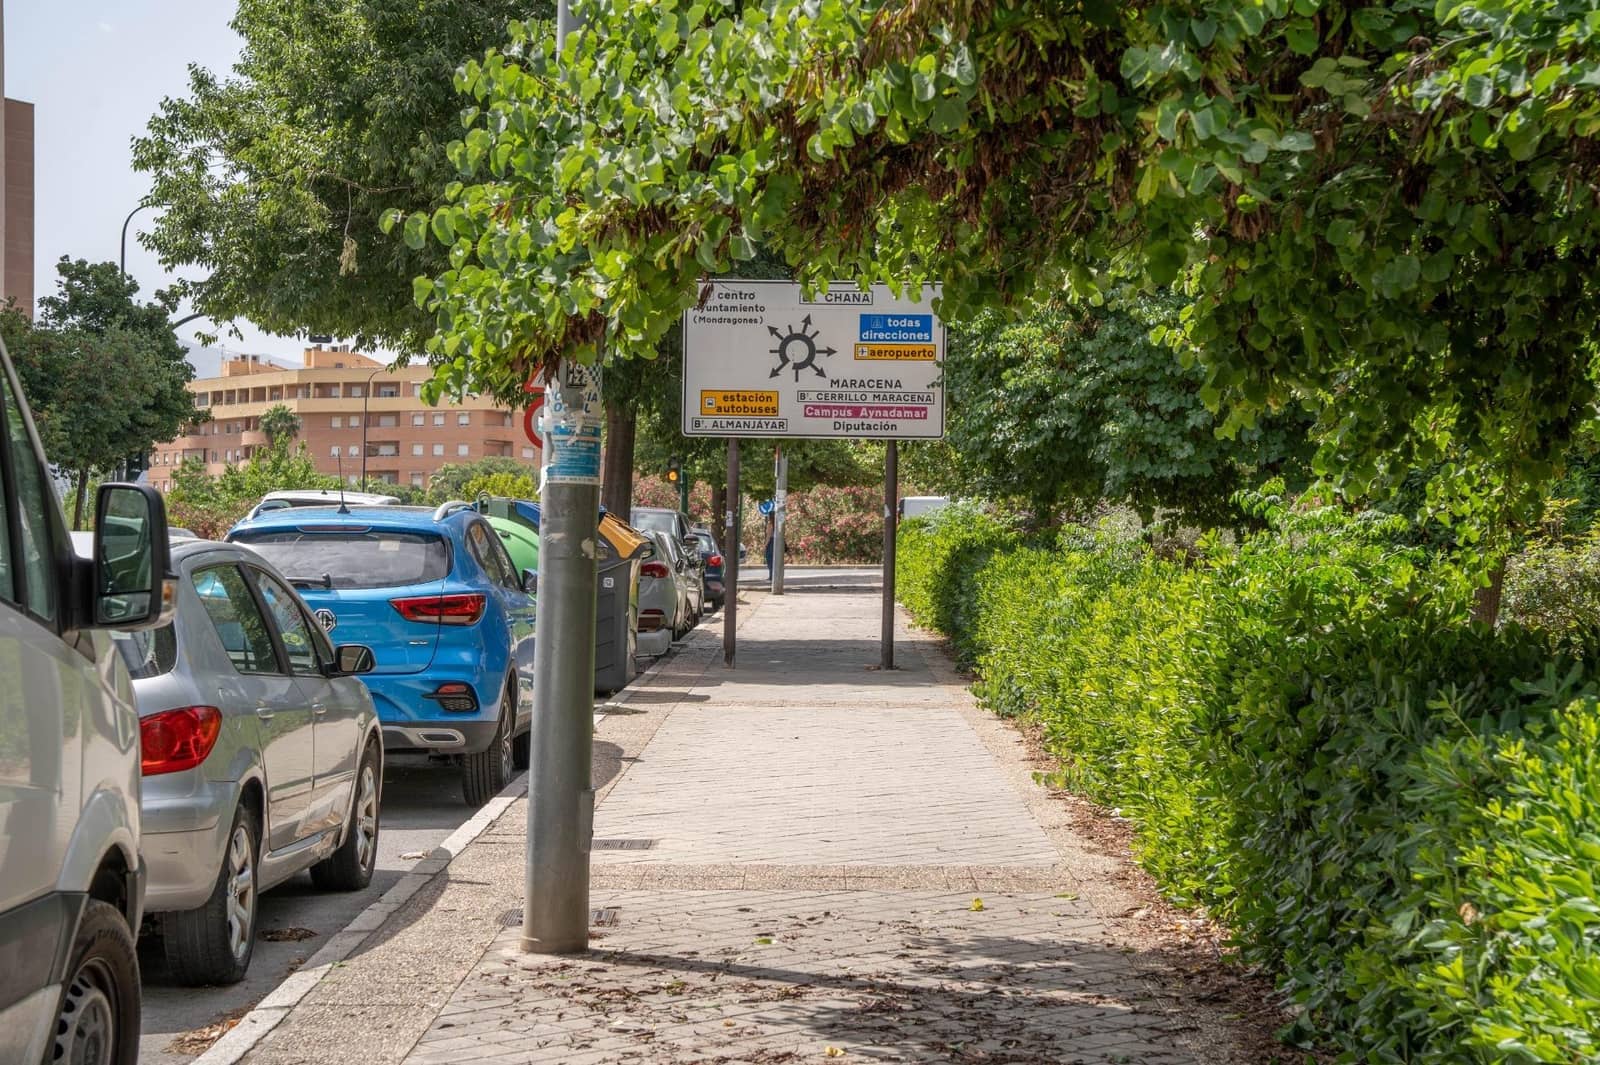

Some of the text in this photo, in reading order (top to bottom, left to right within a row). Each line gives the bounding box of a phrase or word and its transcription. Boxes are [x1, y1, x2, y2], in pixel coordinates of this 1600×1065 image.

[717, 291, 756, 300] centro
[824, 293, 871, 303] CHANA
[693, 315, 764, 326] (Mondragones)
[887, 318, 921, 328] todas
[861, 330, 930, 341] direcciones
[869, 348, 934, 359] aeropuerto
[830, 379, 902, 389] MARACENA
[722, 392, 773, 403] estación
[816, 393, 868, 402] CERRILLO
[872, 394, 933, 403] MARACENA
[715, 403, 778, 414] autobuses
[805, 406, 927, 419] Campus Aynadamar
[712, 419, 786, 430] ALMANJÁYAR
[833, 420, 898, 432] Diputación
